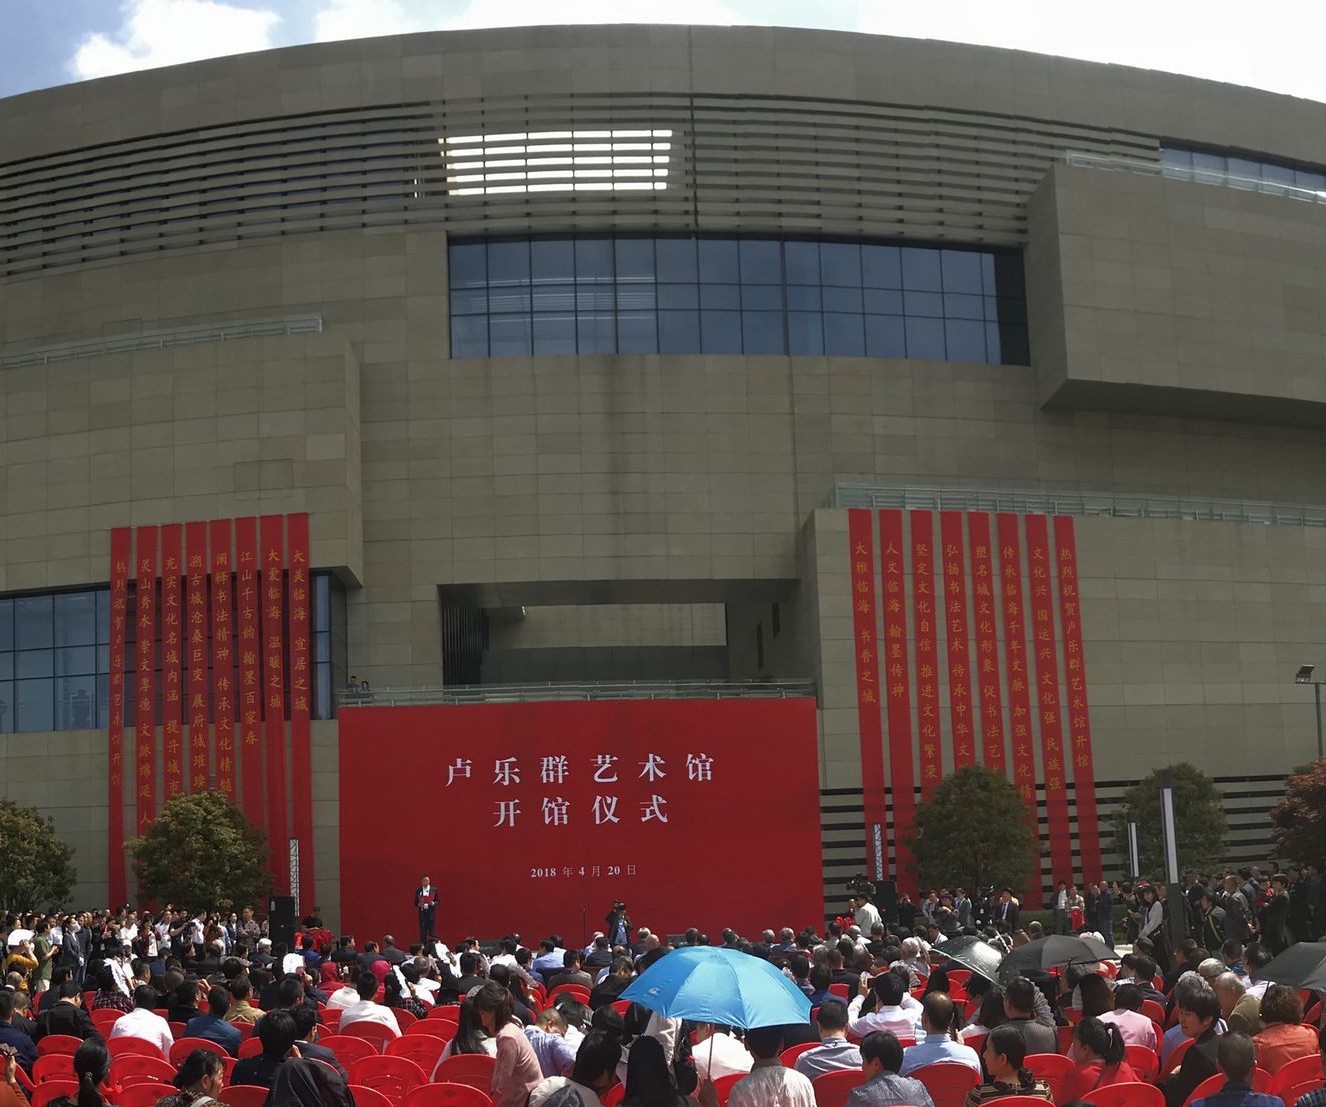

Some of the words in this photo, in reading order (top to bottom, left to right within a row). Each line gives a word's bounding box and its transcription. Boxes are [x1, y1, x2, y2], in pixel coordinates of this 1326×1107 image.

[1060, 549, 1089, 766] 热烈祝贺卢乐群艺术馆开馆
[446, 753, 714, 787] 卢乐群艺术馆
[493, 795, 668, 827] 开馆仪式
